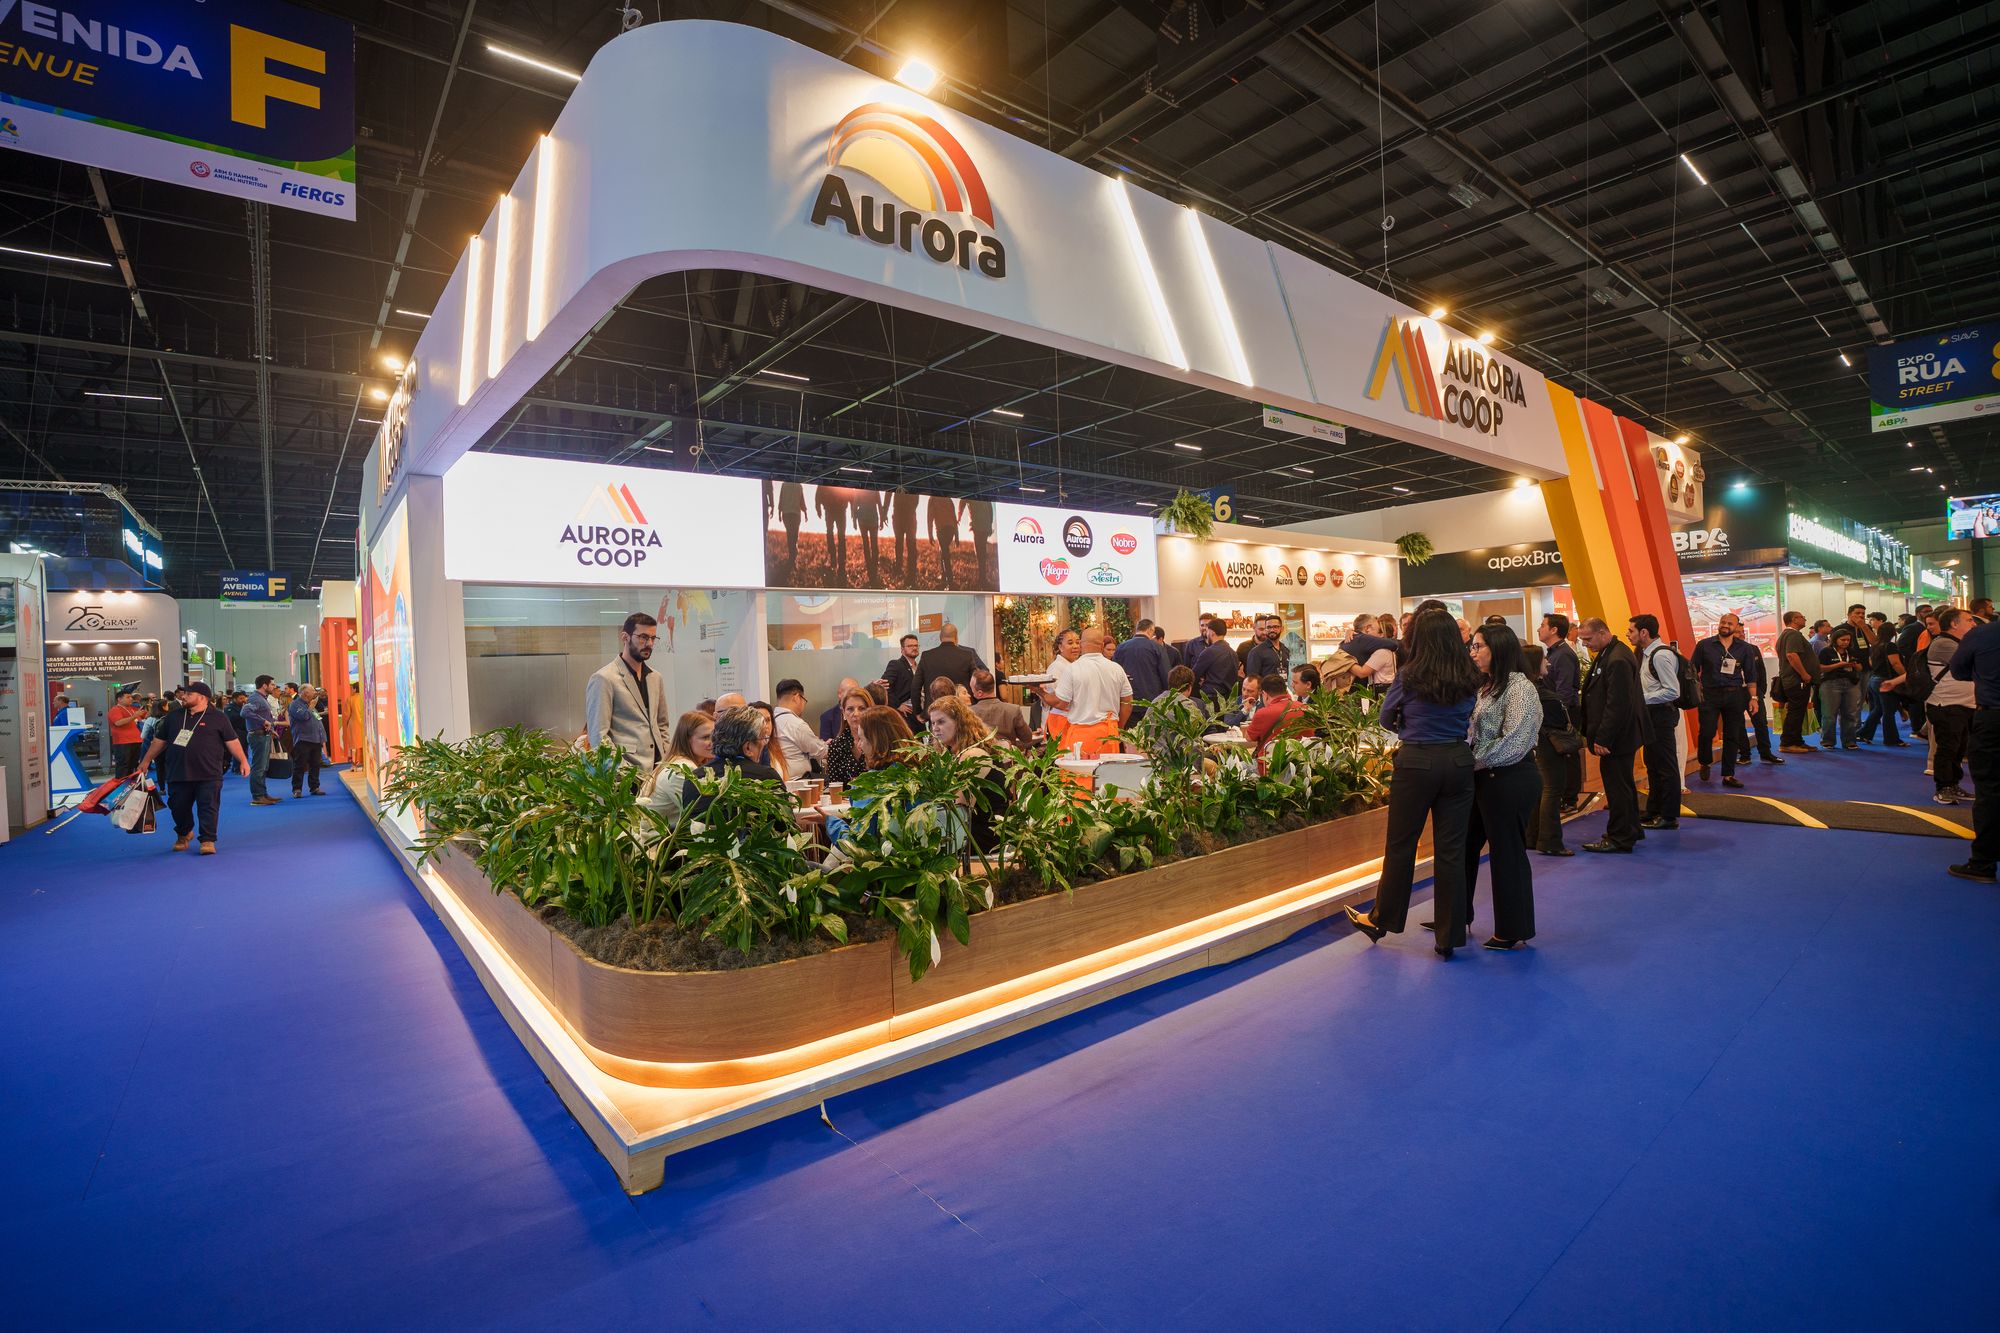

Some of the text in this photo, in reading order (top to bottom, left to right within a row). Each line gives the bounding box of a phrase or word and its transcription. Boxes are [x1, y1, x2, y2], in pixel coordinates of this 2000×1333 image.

[230, 24, 326, 129] F
[214, 173, 268, 189] ANIMAL NUTRITION
[233, 172, 259, 182] HAMMER
[811, 174, 1006, 279] Aurora
[1898, 353, 1935, 367] EXPO
[1443, 339, 1527, 408] AURORA
[1899, 357, 1966, 385] RUA
[1899, 380, 1954, 399] STREET
[1442, 383, 1503, 437] COOP
[1215, 495, 1231, 521] 6
[560, 524, 663, 548] AURORA
[1013, 533, 1045, 544] Aurora
[1066, 534, 1091, 544] Aurora
[1112, 537, 1136, 548] Nobre
[577, 547, 647, 567] COOP
[1042, 563, 1069, 581] Alegra
[1226, 562, 1265, 576] AURORA
[268, 578, 286, 596] F
[1091, 575, 1120, 583] Mestri
[1227, 576, 1254, 589] COOP
[1276, 577, 1293, 586] Aurora
